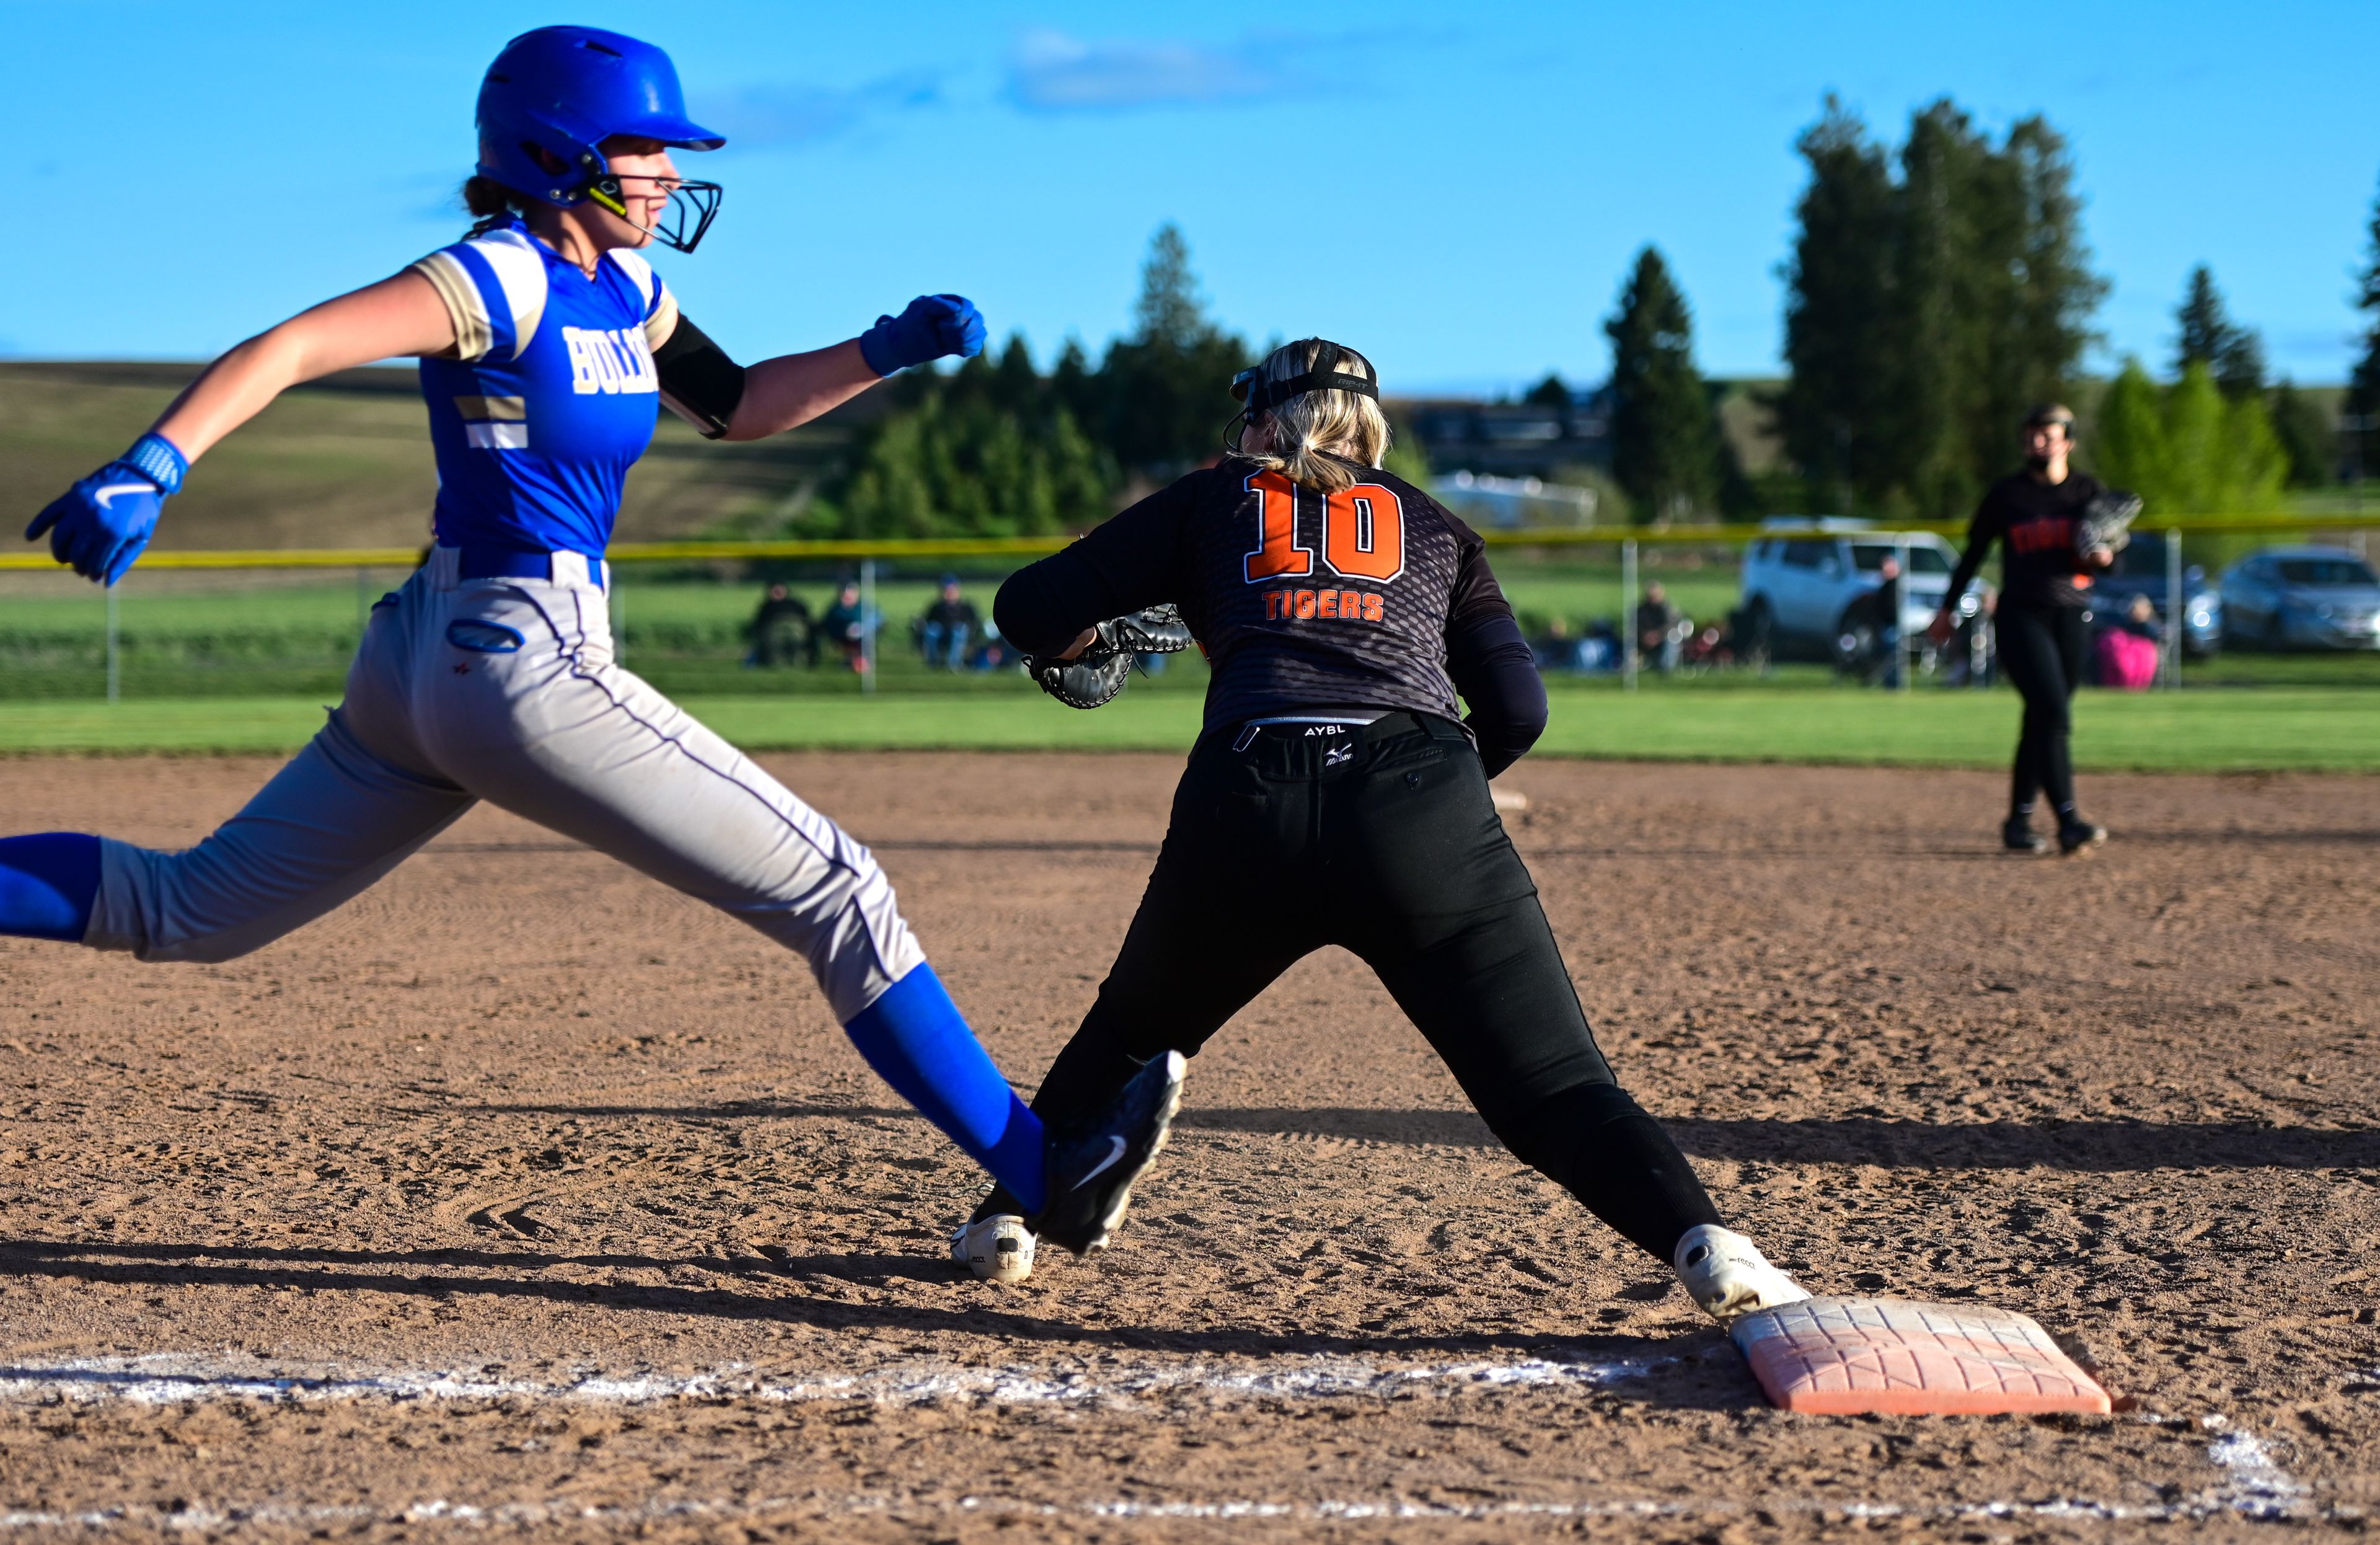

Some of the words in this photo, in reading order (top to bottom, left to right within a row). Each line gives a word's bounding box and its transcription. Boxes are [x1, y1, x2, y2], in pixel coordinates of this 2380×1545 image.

[1338, 378, 1368, 389] RIP-IT
[1244, 467, 1404, 583] 10
[1262, 590, 1383, 621] TIGERS
[1305, 725, 1346, 737] AYBL
